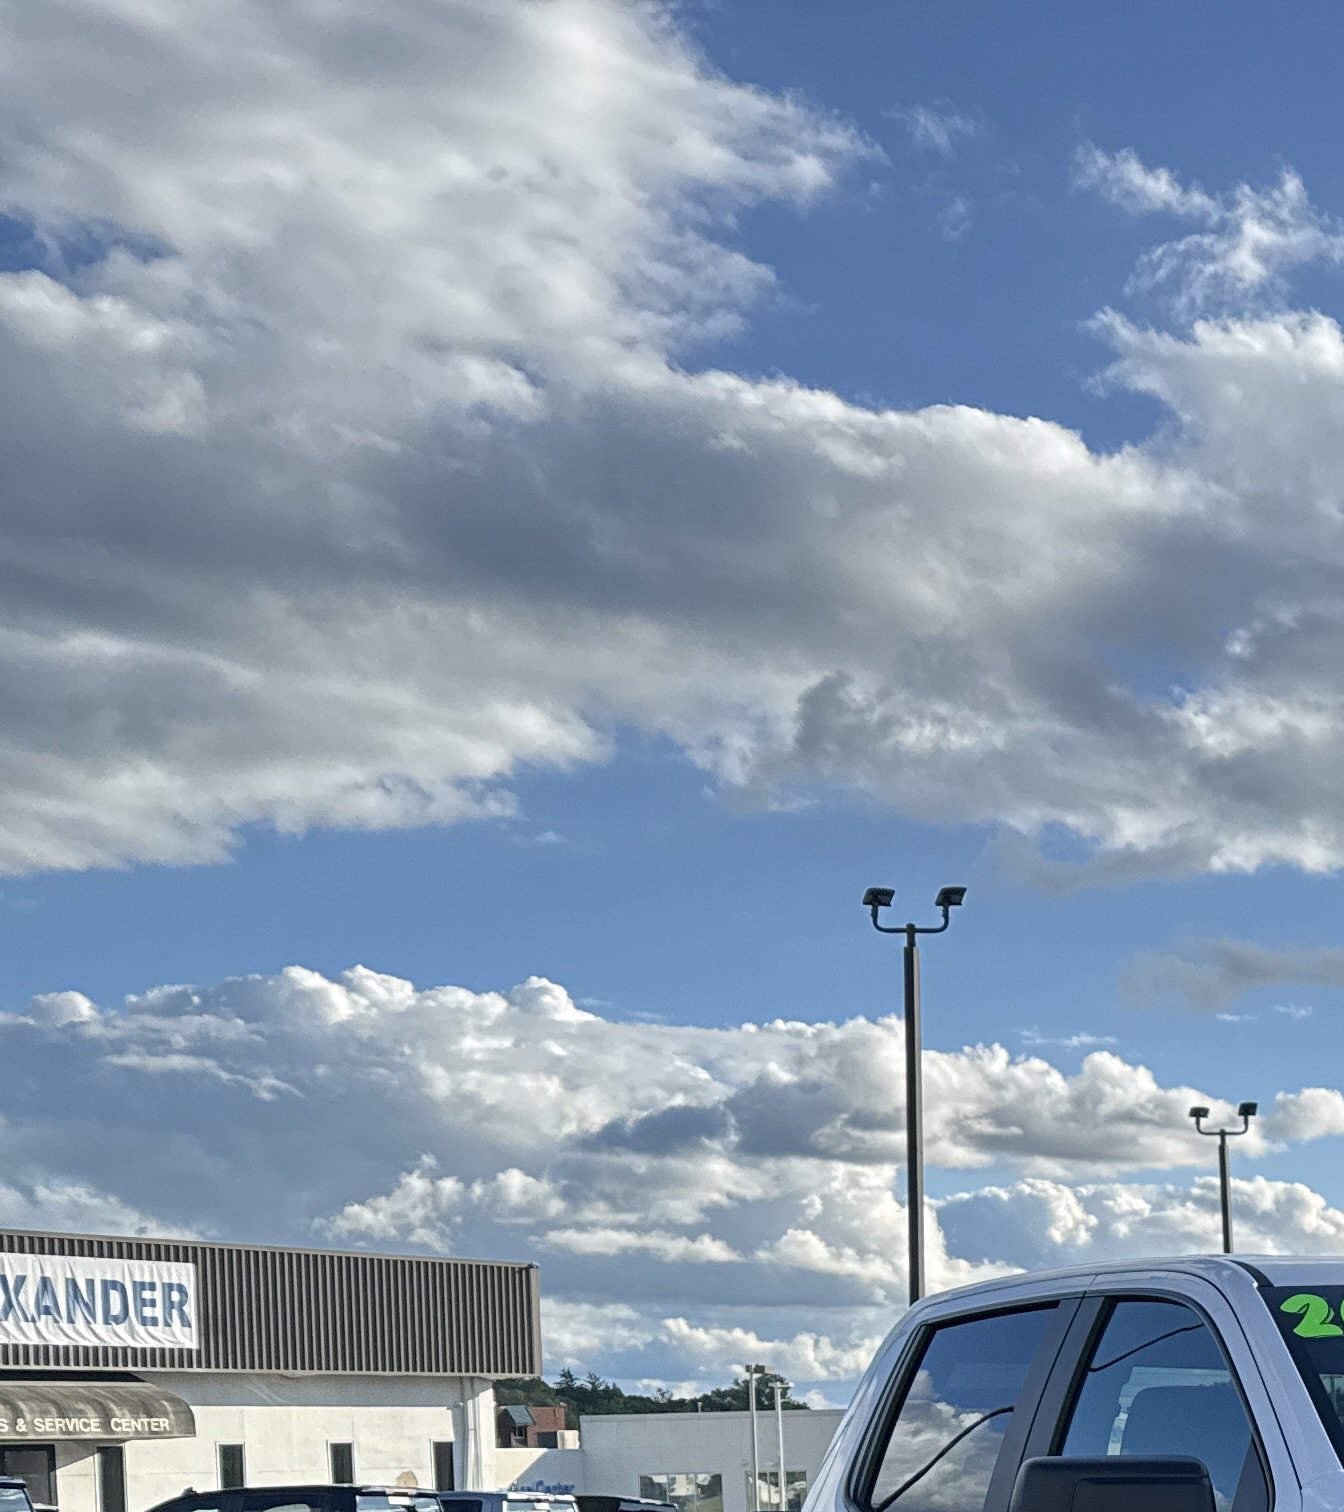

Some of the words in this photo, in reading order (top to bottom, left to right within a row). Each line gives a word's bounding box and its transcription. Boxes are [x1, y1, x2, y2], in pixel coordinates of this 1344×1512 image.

[0, 1274, 192, 1328] XANDER
[16, 1417, 27, 1433] &
[34, 1418, 101, 1432] SERVICE
[111, 1418, 170, 1432] CENTER
